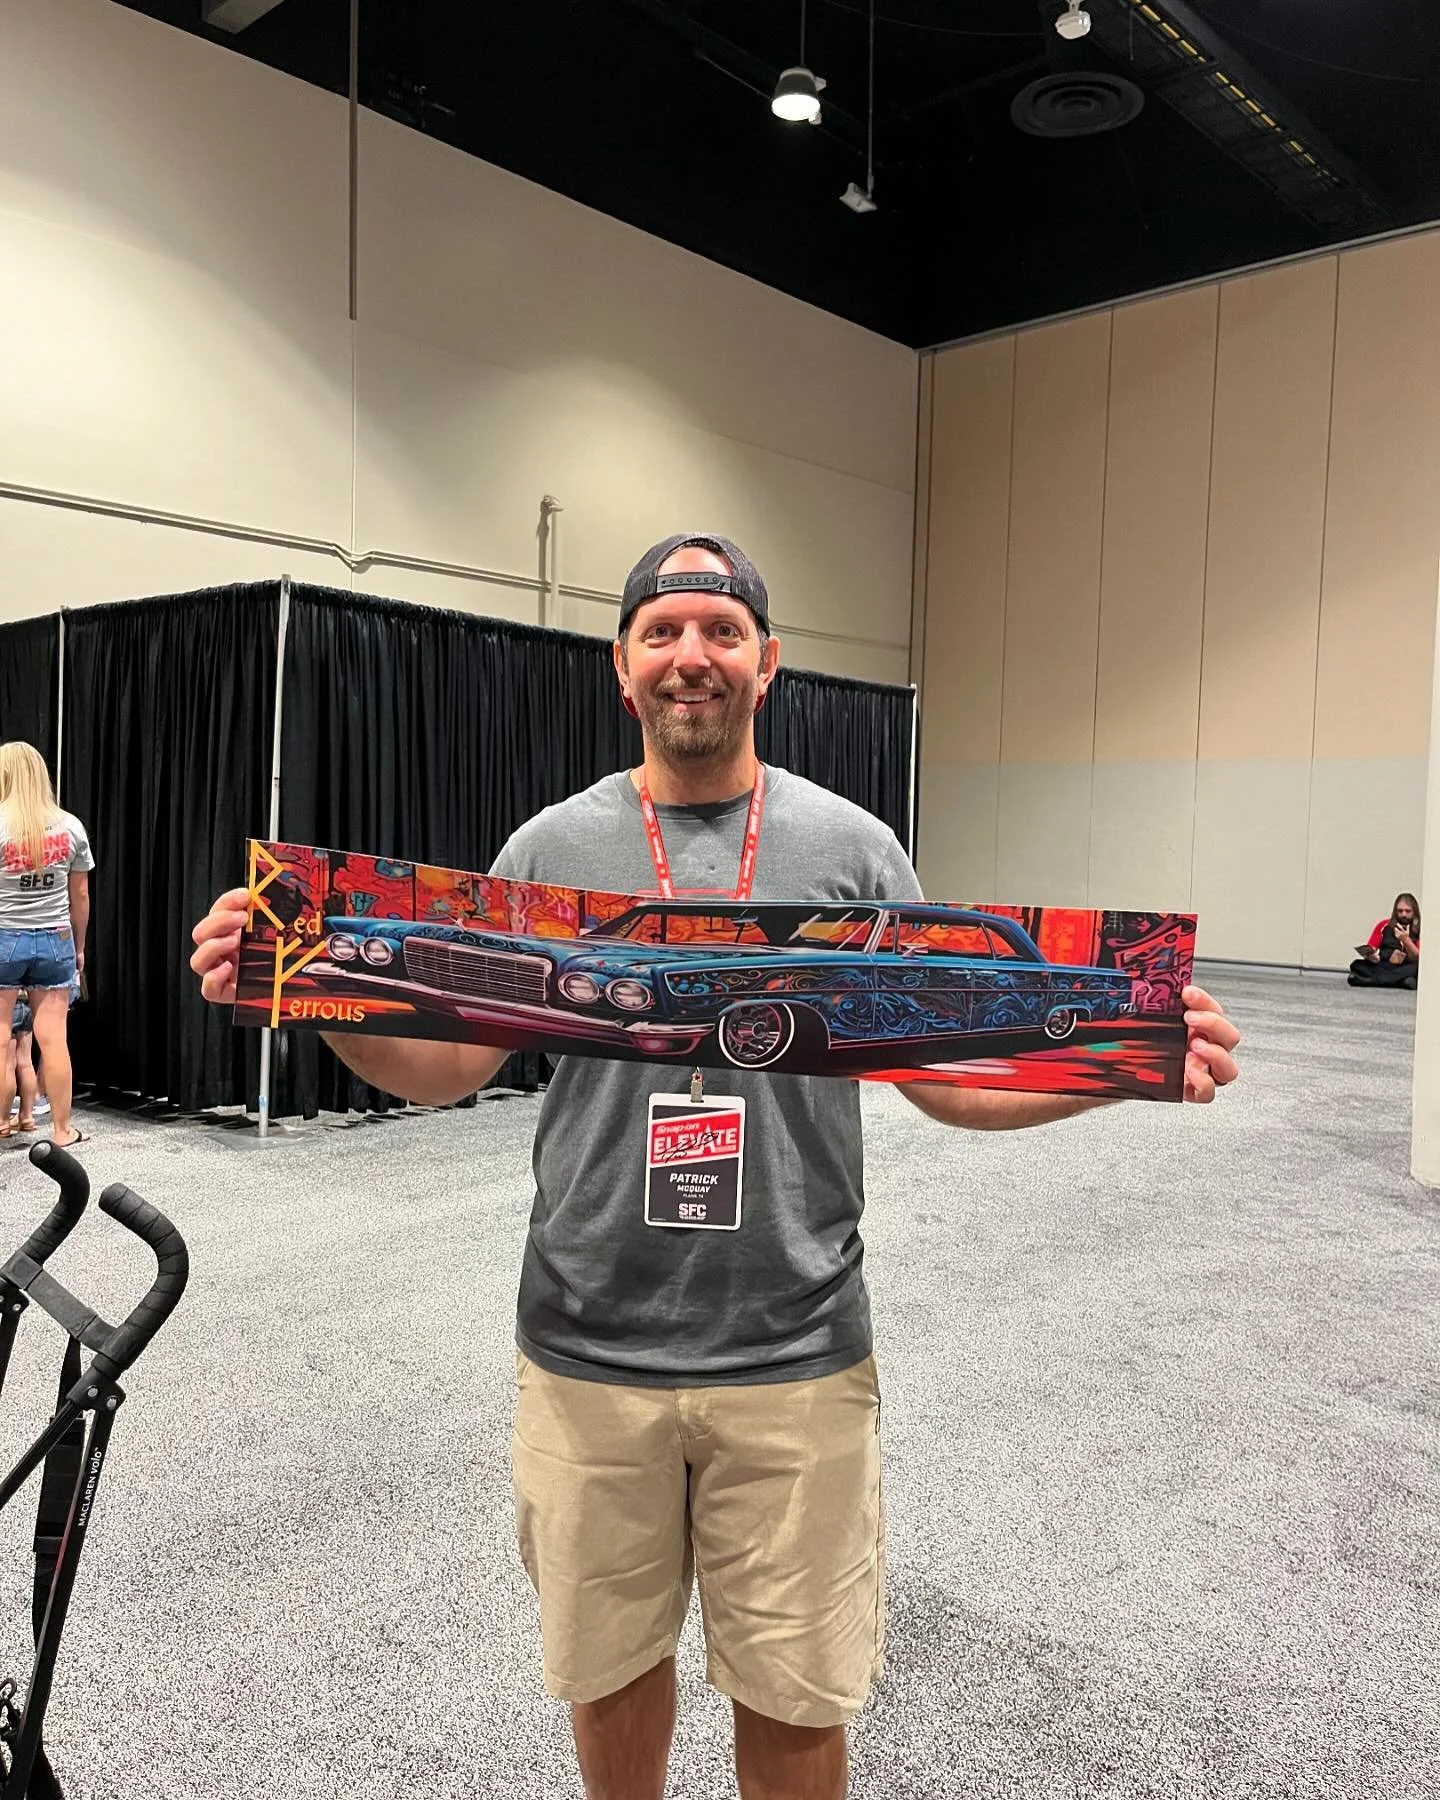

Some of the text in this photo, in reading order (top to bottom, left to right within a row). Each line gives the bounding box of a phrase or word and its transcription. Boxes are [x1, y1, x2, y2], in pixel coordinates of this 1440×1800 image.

[19, 873, 55, 887] SFC
[245, 839, 322, 936] Red
[270, 935, 367, 1029] Ferrous
[656, 1122, 700, 1134] Snap-on
[653, 1124, 738, 1154] ELEVATE
[669, 1173, 719, 1185] PATRICK
[677, 1185, 711, 1193] MCQUAY
[678, 1203, 707, 1216] SFC
[78, 1476, 97, 1527] MACLAREN
